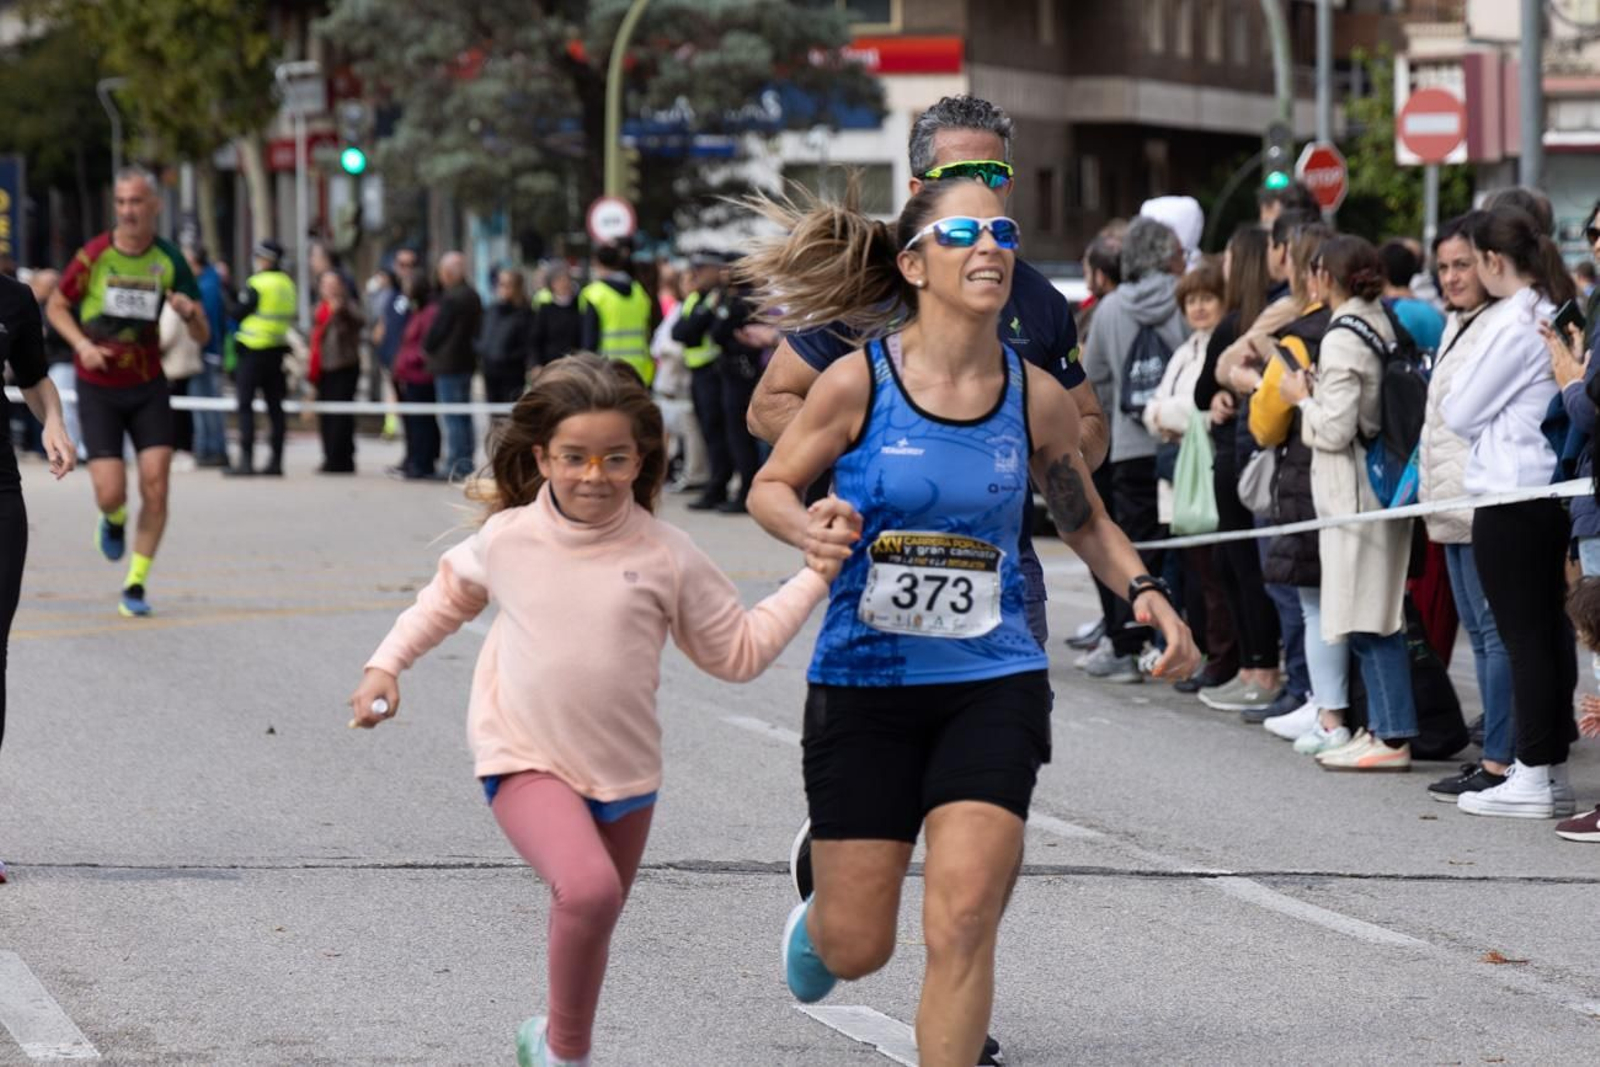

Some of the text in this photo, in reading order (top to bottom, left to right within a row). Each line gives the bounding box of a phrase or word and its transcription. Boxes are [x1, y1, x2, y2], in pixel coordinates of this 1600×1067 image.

[1305, 168, 1343, 187] STOP
[874, 536, 903, 553] XXV
[905, 537, 952, 547] CARRERA
[916, 546, 945, 556] gran
[950, 548, 997, 558] caminata
[892, 573, 973, 614] 373
